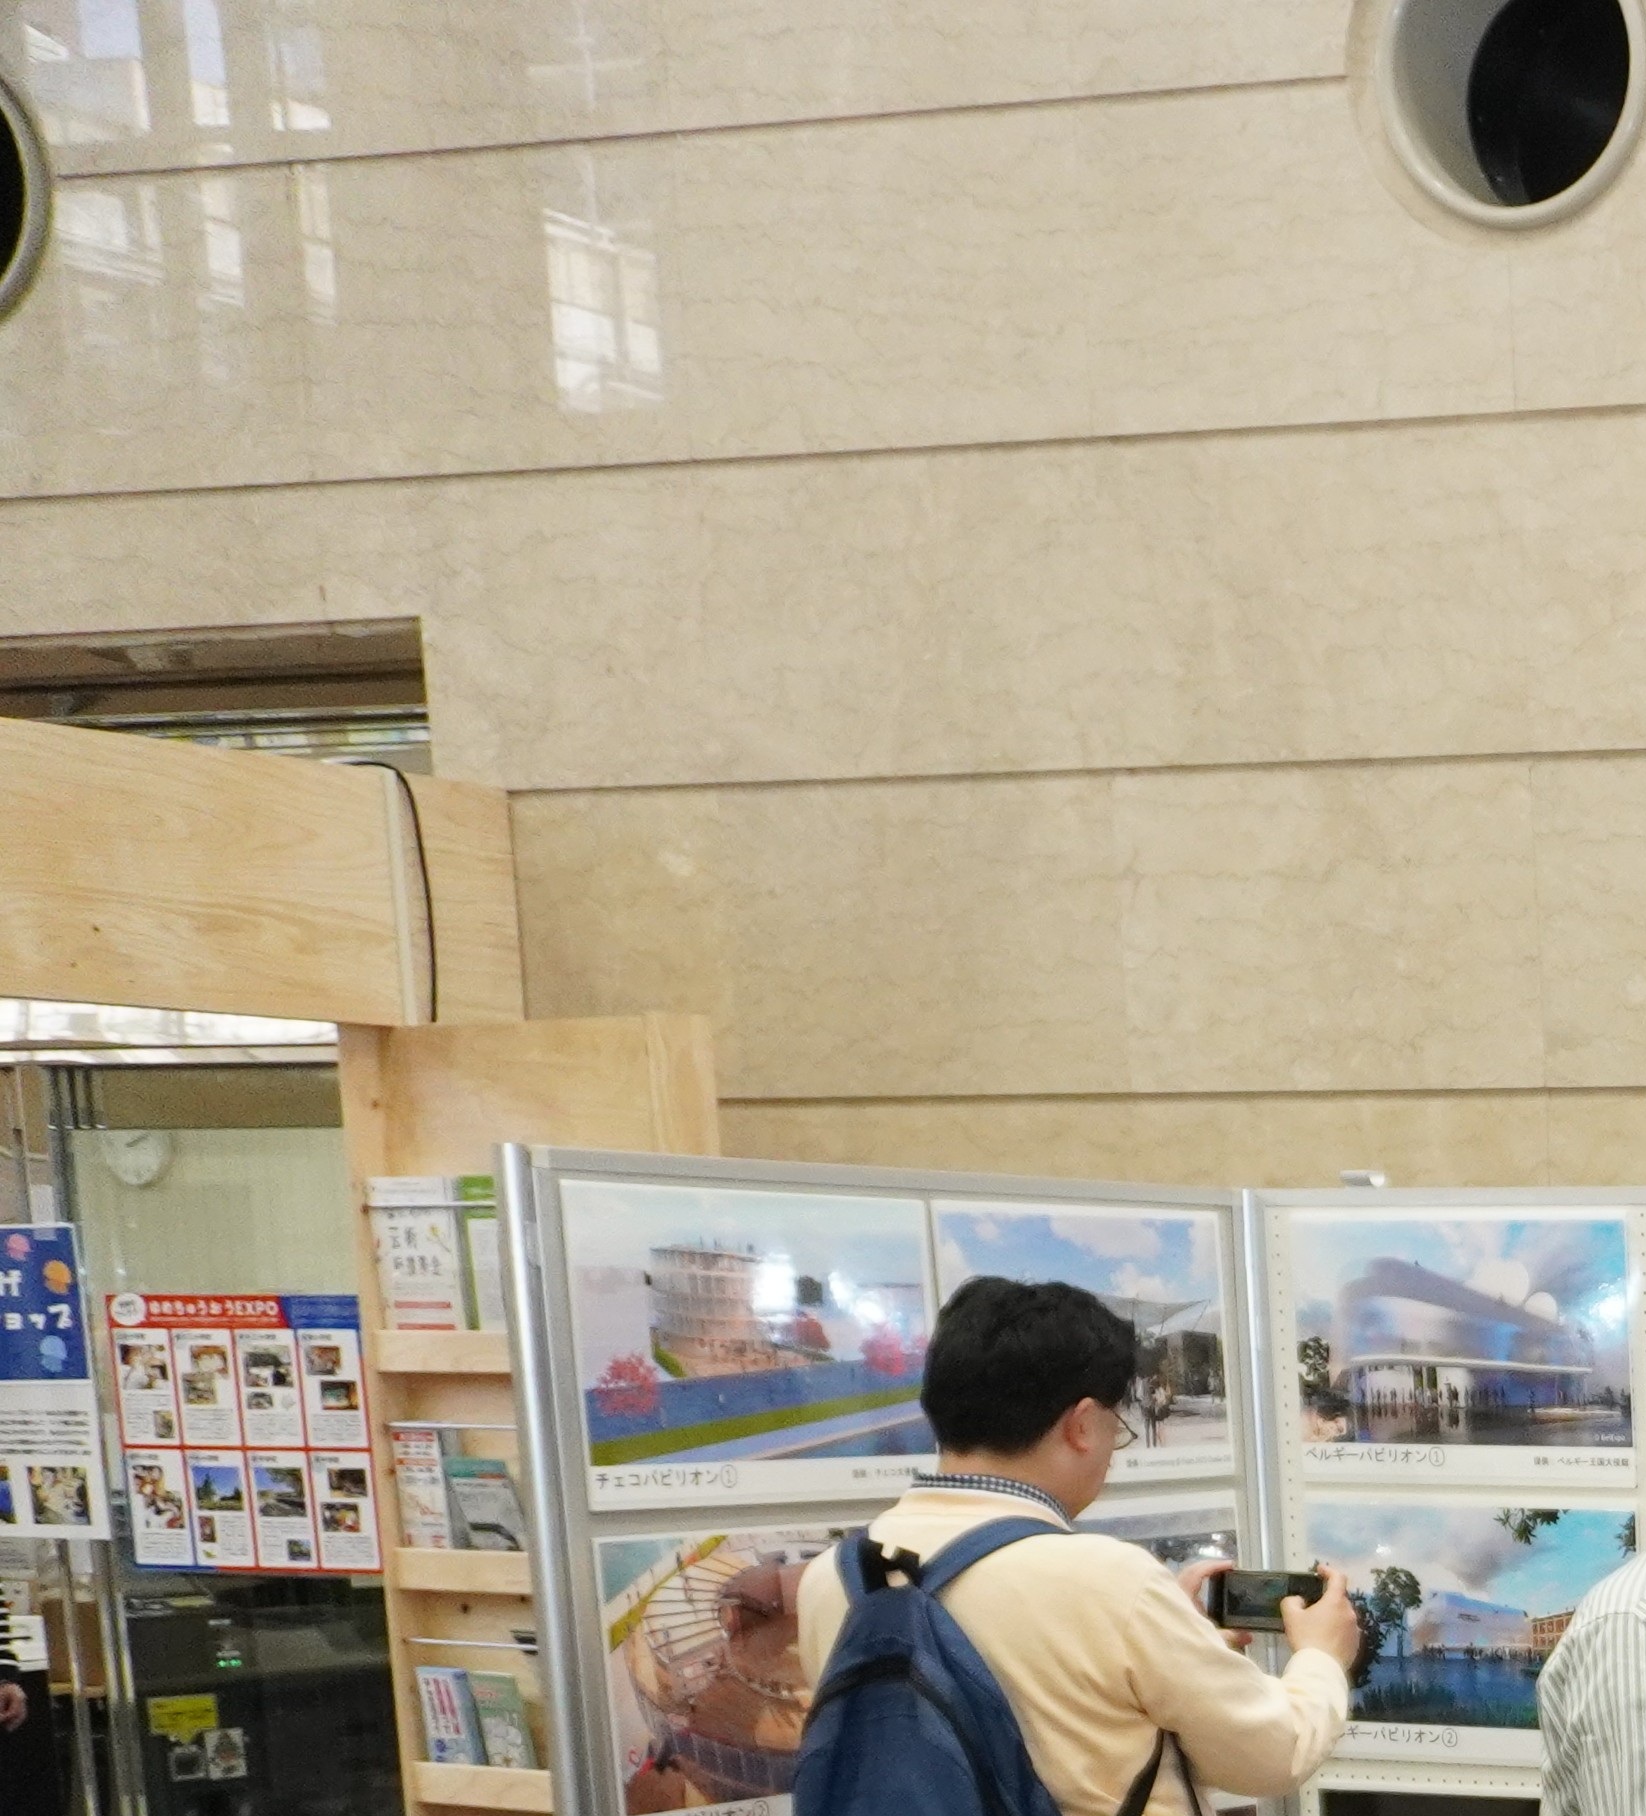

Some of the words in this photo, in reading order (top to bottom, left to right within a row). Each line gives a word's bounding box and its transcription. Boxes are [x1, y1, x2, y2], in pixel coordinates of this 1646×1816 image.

[1339, 1724, 1458, 1748] ギーパビリオン②
